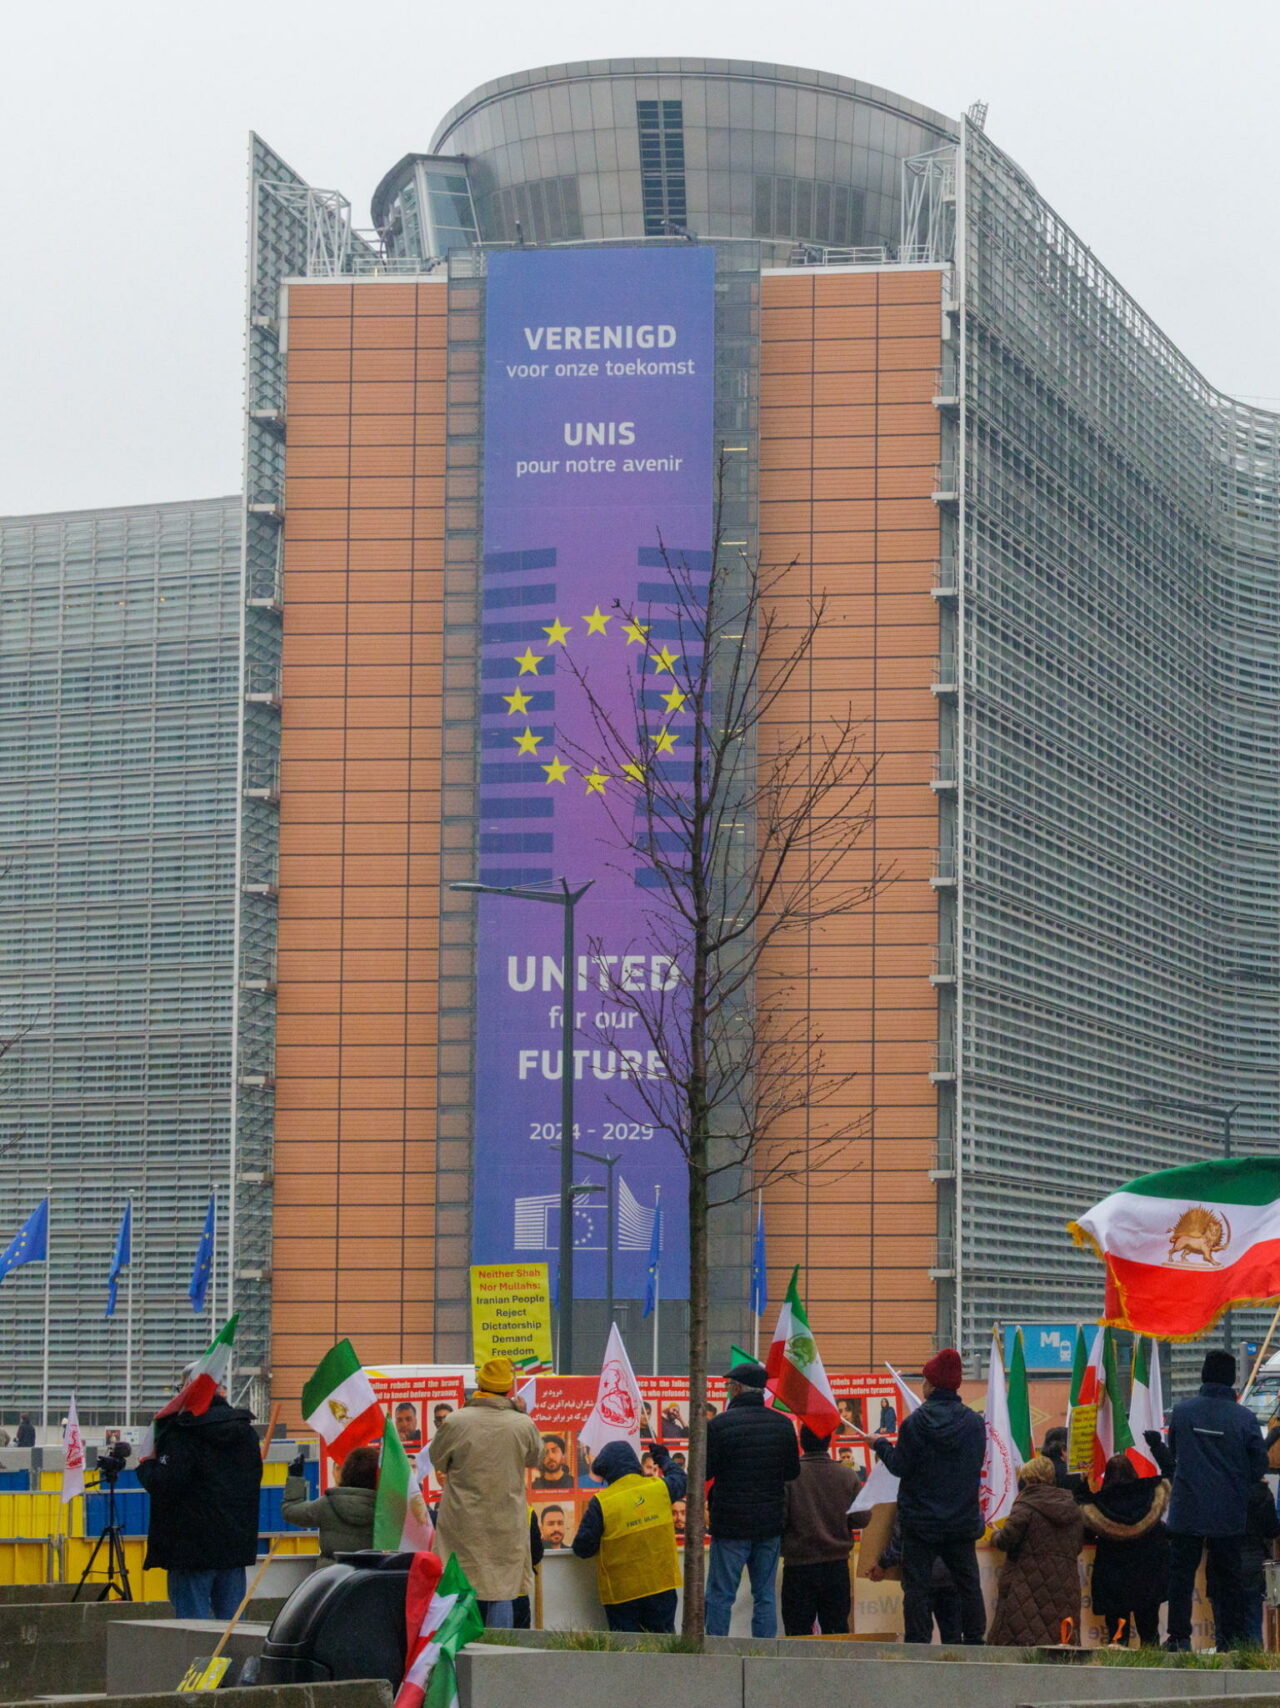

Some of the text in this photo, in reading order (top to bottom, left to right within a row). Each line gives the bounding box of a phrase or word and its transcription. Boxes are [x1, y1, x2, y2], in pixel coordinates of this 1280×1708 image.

[524, 325, 677, 350] VERENIGD
[506, 358, 696, 378] voor onze toekomst
[564, 422, 636, 446] UNIS
[516, 454, 683, 478] pour notre avenir
[508, 955, 678, 992] UNITED
[595, 1012, 639, 1029] our
[518, 1050, 669, 1080] FUTURE
[602, 1122, 655, 1141] 2029
[478, 1268, 541, 1279] Neither Shah
[479, 1282, 541, 1292] Nor Mullahs:
[476, 1295, 545, 1304] Iranian People
[495, 1308, 527, 1318] Reject
[481, 1320, 542, 1331] Dictatorship
[492, 1334, 533, 1343] Demand
[491, 1347, 535, 1357] Freedom
[413, 1381, 426, 1389] and
[428, 1380, 439, 1388] the
[441, 1379, 459, 1387] brave
[866, 1377, 877, 1385] the
